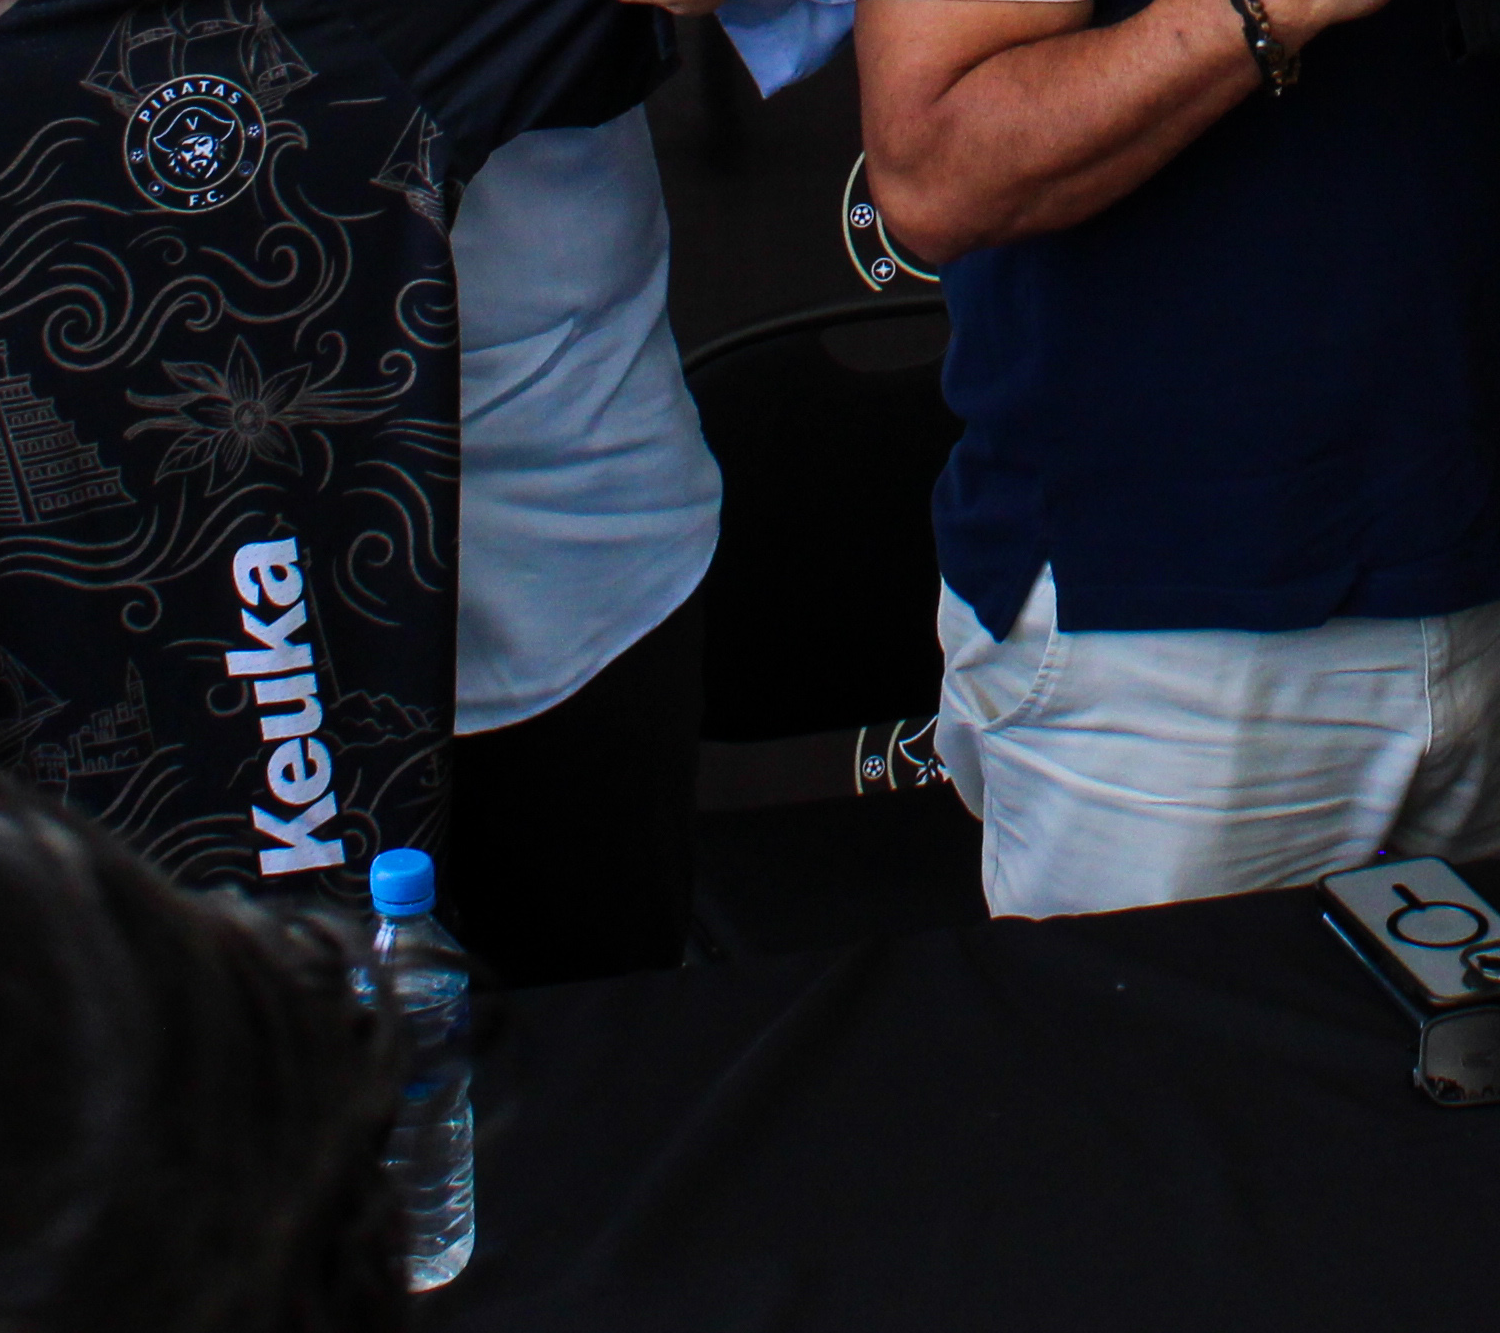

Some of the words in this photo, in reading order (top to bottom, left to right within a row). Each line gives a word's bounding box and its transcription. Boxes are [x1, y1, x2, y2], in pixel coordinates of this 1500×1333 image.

[138, 80, 238, 131] PIRATAS
[188, 190, 225, 207] F.C.
[225, 537, 344, 876] Keuka
